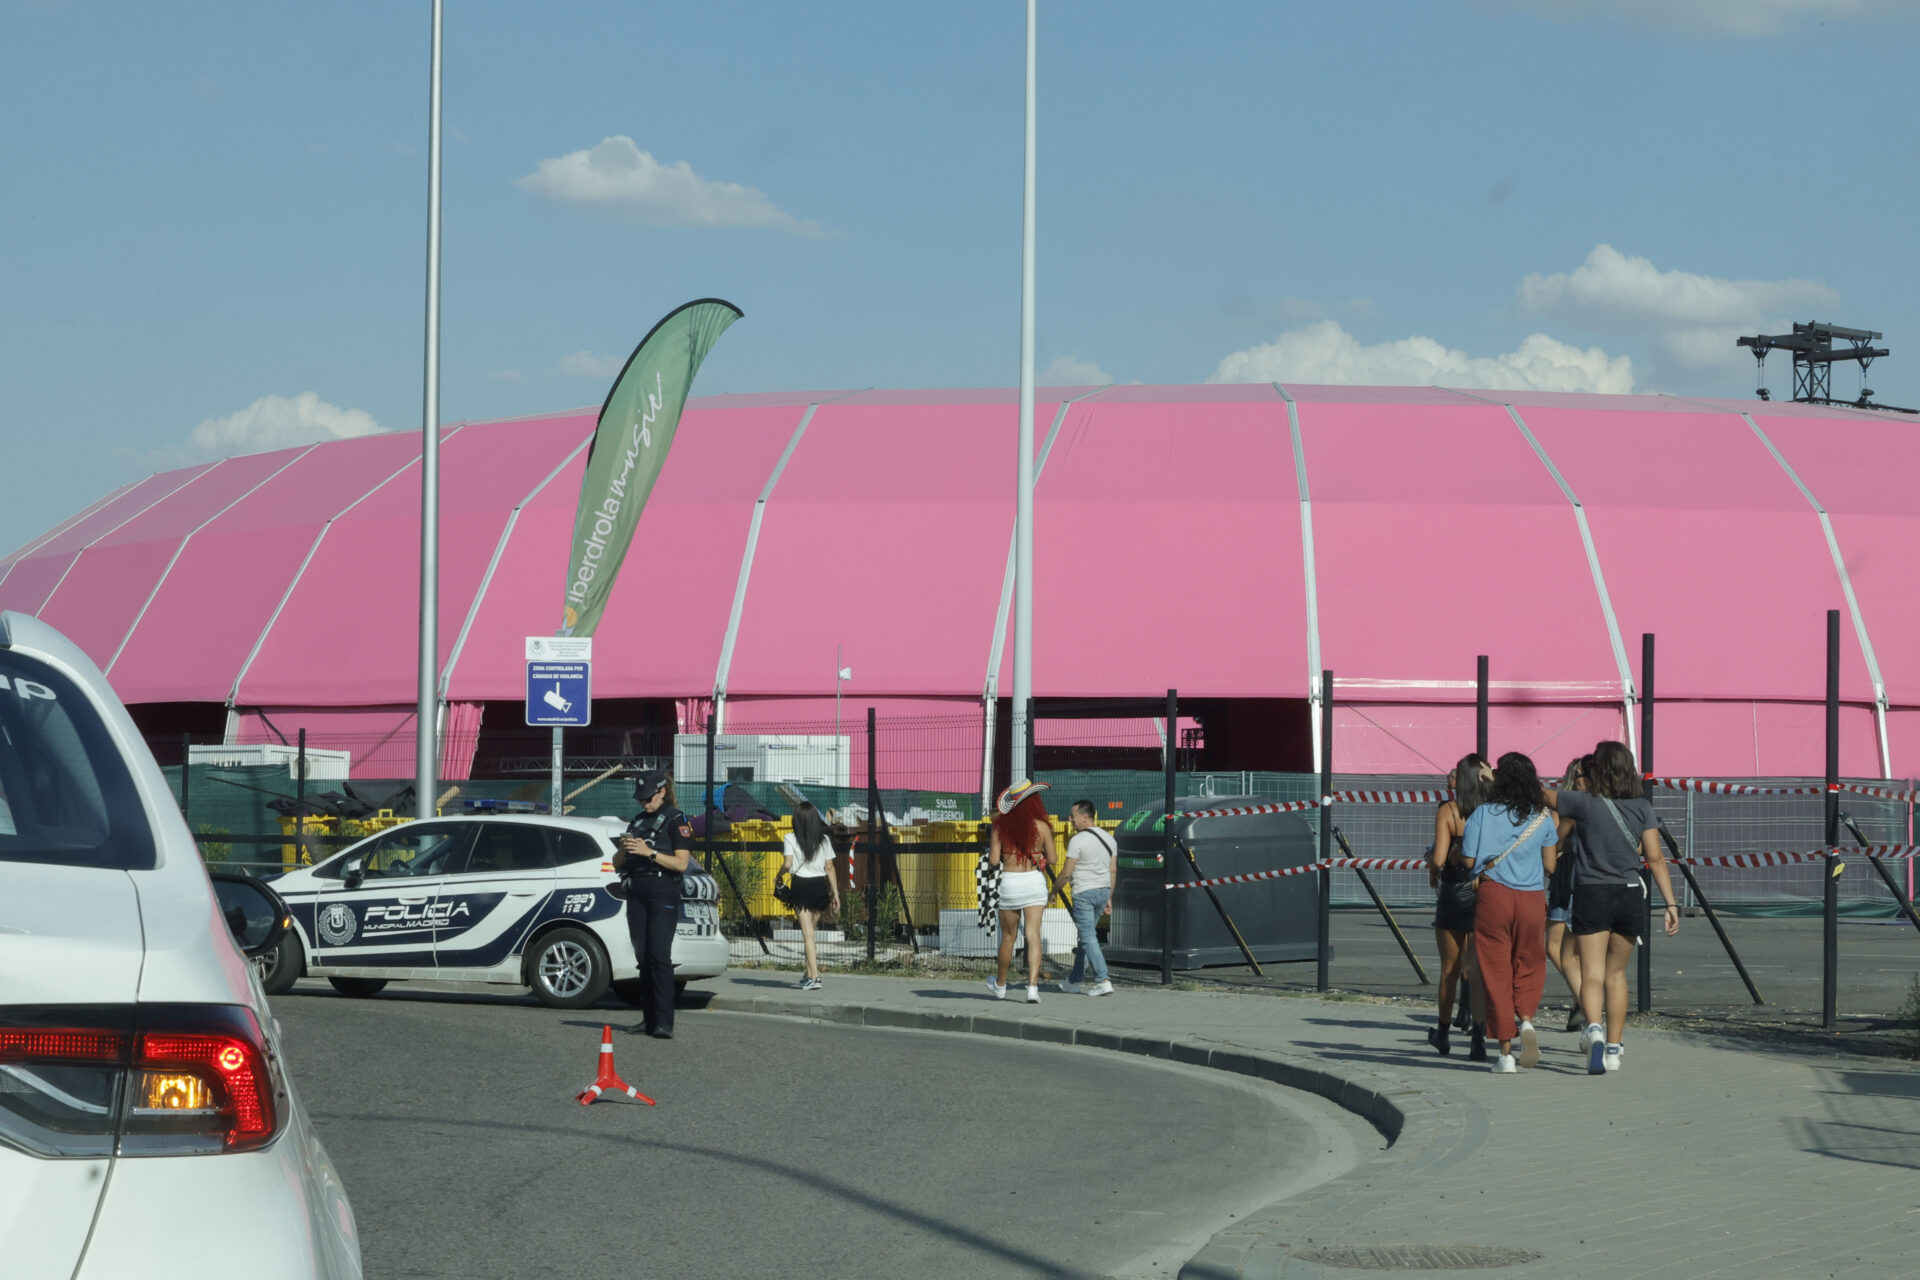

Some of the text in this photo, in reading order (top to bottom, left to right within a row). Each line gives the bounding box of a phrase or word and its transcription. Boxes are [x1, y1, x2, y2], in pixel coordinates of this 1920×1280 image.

[936, 799, 957, 809] SALIDA
[564, 894, 589, 904] 092
[561, 903, 582, 914] 112
[363, 917, 450, 931] MUNICIPAL MADRID
